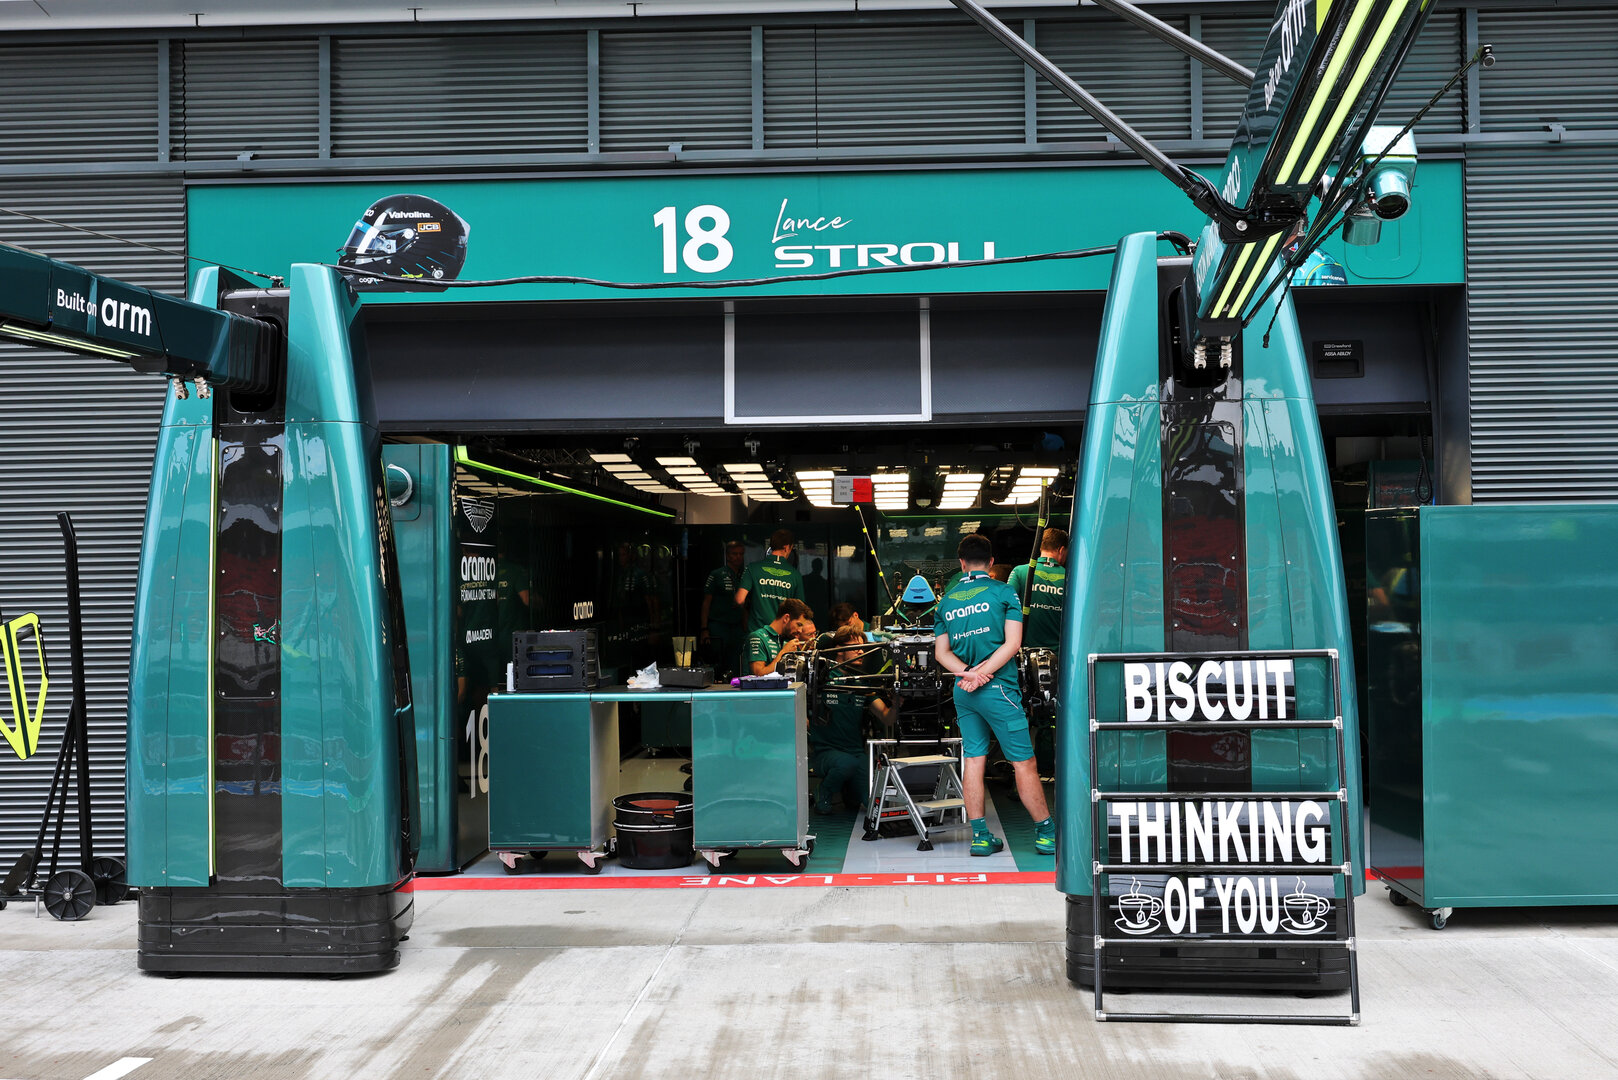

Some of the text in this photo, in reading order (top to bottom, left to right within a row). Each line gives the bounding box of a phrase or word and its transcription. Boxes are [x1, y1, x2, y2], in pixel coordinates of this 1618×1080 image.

[388, 211, 431, 219] Valvoline
[771, 198, 853, 243] Lance
[653, 204, 734, 274] 18
[56, 288, 151, 337] Built on arm
[460, 555, 496, 582] aramco
[759, 578, 792, 589] aramco
[1031, 583, 1064, 596] ramc
[573, 601, 594, 620] aramco
[945, 602, 990, 621] aramco
[958, 626, 991, 640] Honda
[1124, 659, 1292, 722] BISCUIT
[465, 703, 489, 799] 18
[1112, 800, 1326, 863] THINKING
[680, 874, 833, 885] LANE
[893, 874, 987, 883] PIT
[1164, 876, 1280, 934] OF YOU
